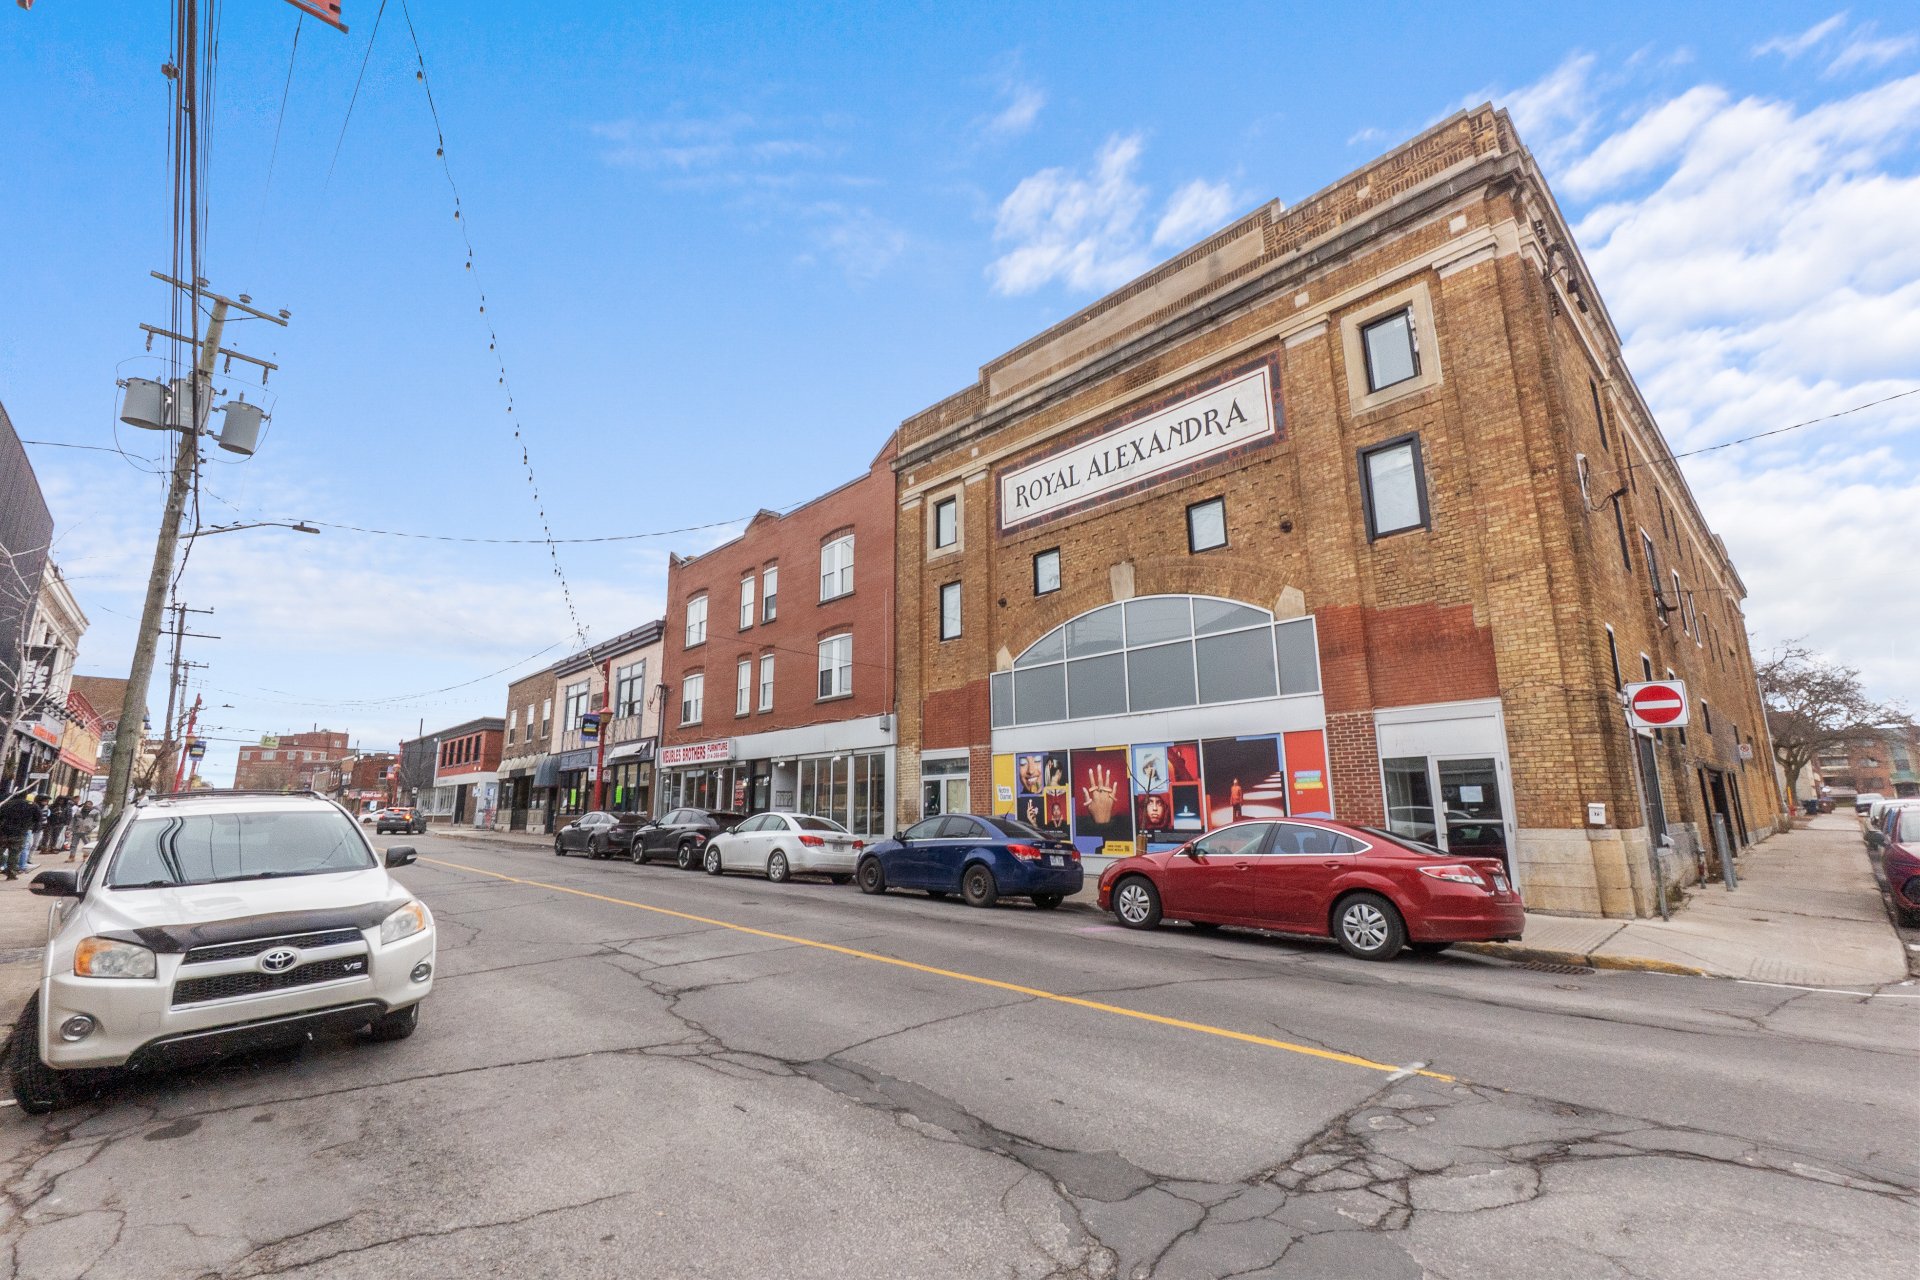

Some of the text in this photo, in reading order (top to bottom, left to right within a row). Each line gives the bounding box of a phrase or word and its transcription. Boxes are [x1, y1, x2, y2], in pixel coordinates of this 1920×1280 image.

[1015, 398, 1248, 508] ROYAL ALEXANDRA
[662, 741, 728, 764] MEUBLES BROTHERS FURNITURE
[344, 962, 362, 971] V6
